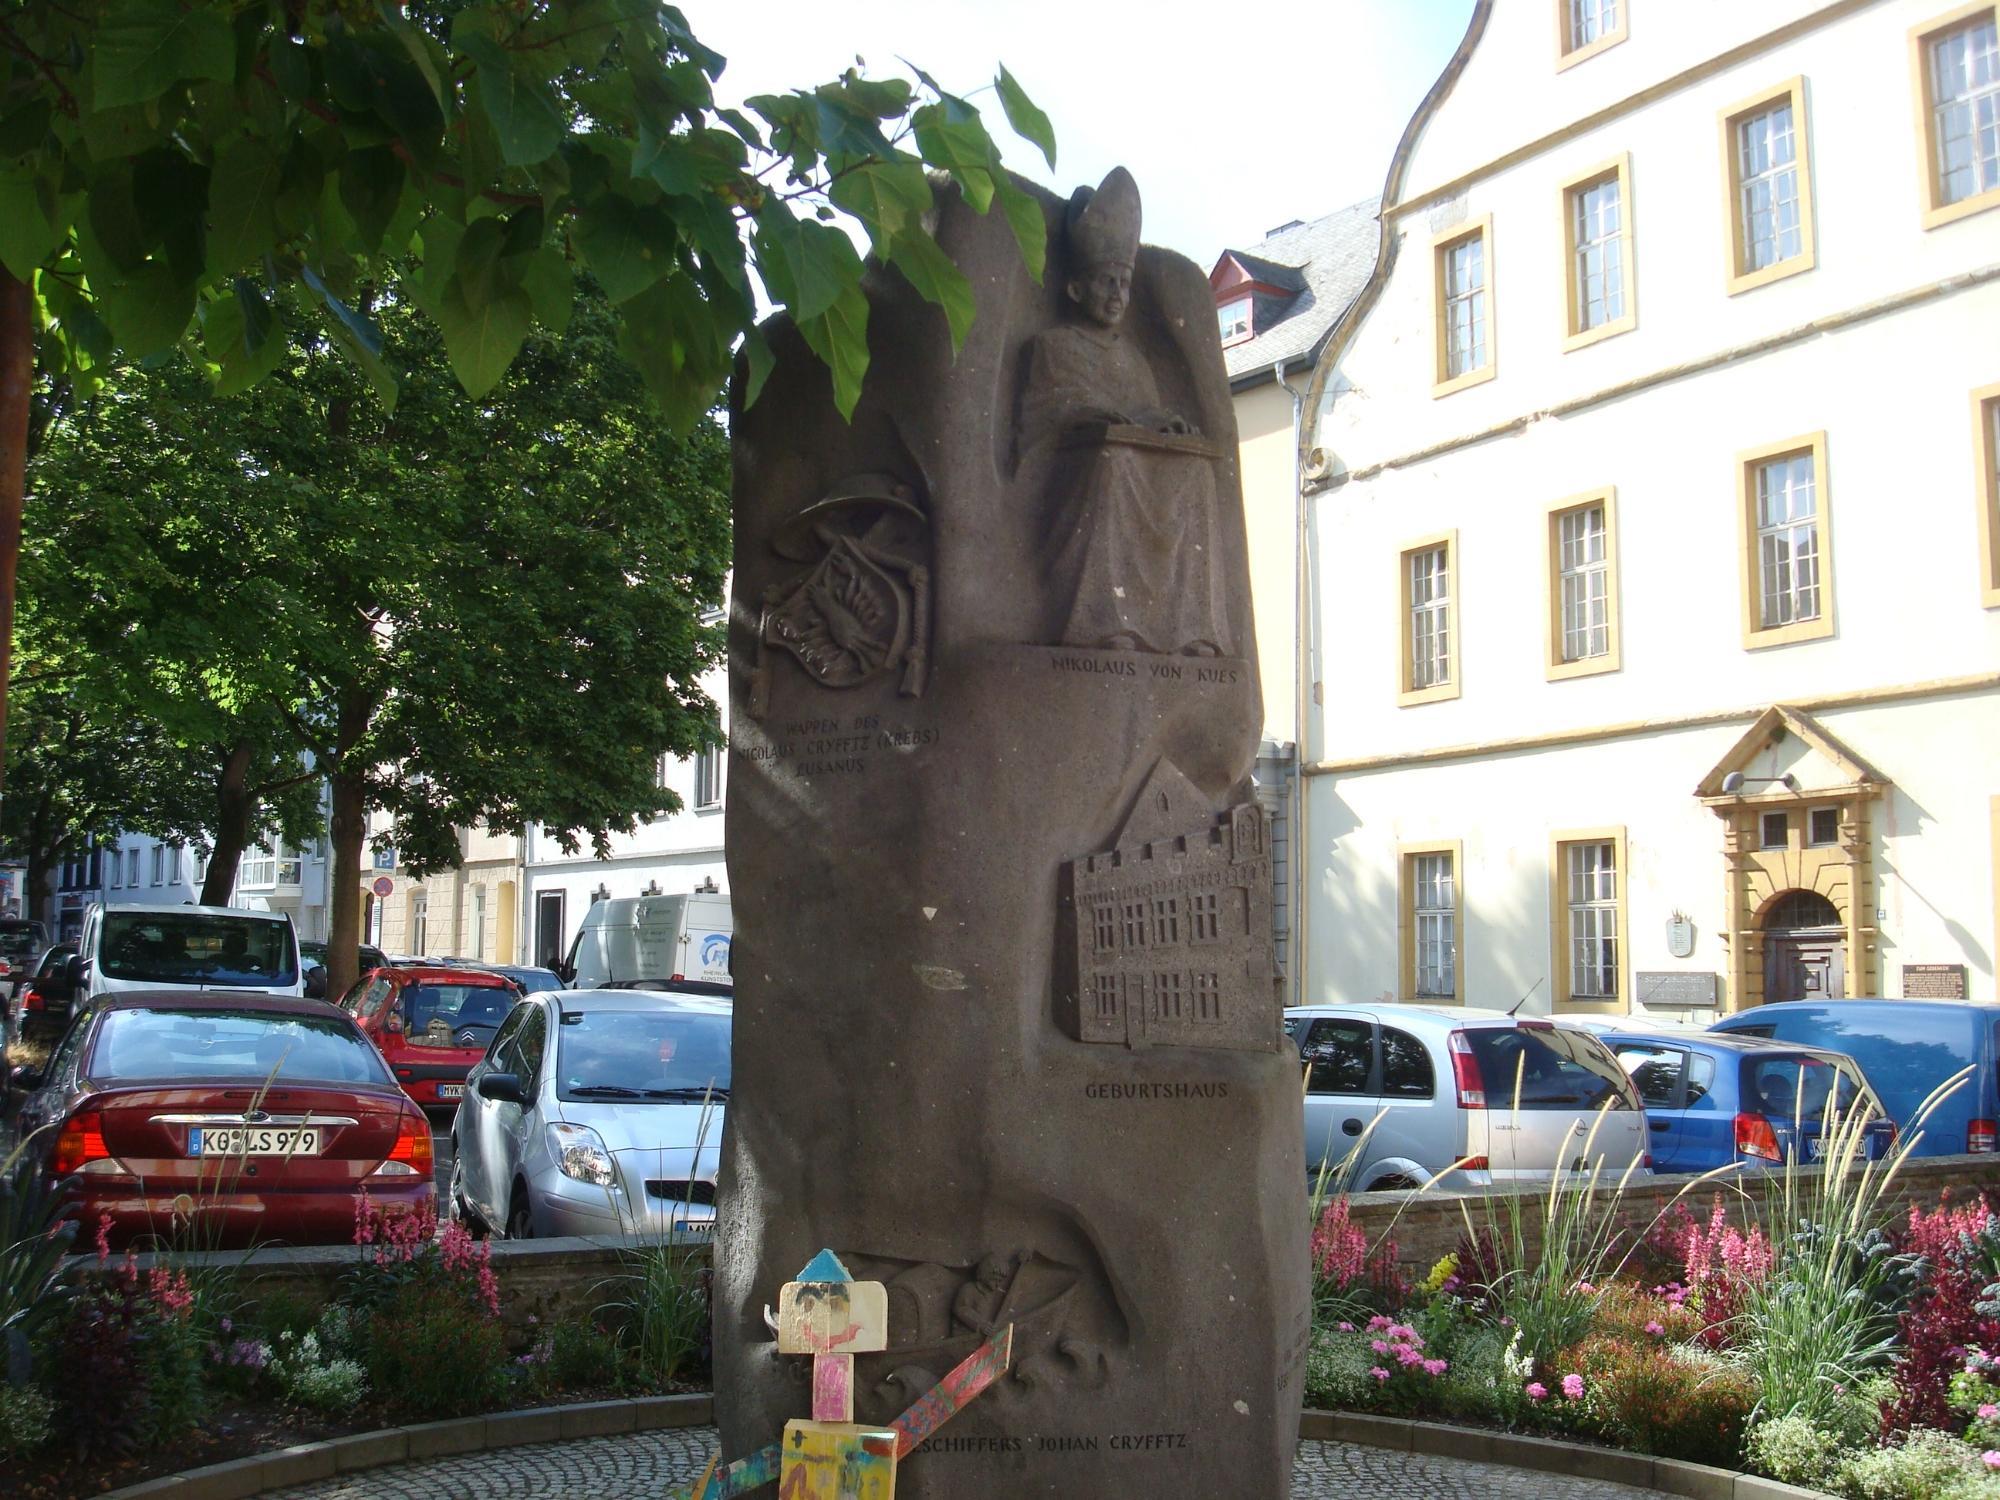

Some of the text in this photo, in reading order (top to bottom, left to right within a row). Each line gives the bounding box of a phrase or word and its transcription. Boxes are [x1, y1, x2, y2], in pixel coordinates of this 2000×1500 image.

[1051, 656, 1237, 684] NIKOLAUS VON KUES
[785, 715, 881, 737] WAPPEN DES
[379, 851, 391, 867] P
[1085, 1081, 1229, 1099] GEBURTSHAUS
[912, 1433, 1187, 1453] SCHIFFERS JOHAN CRYFFTZ
